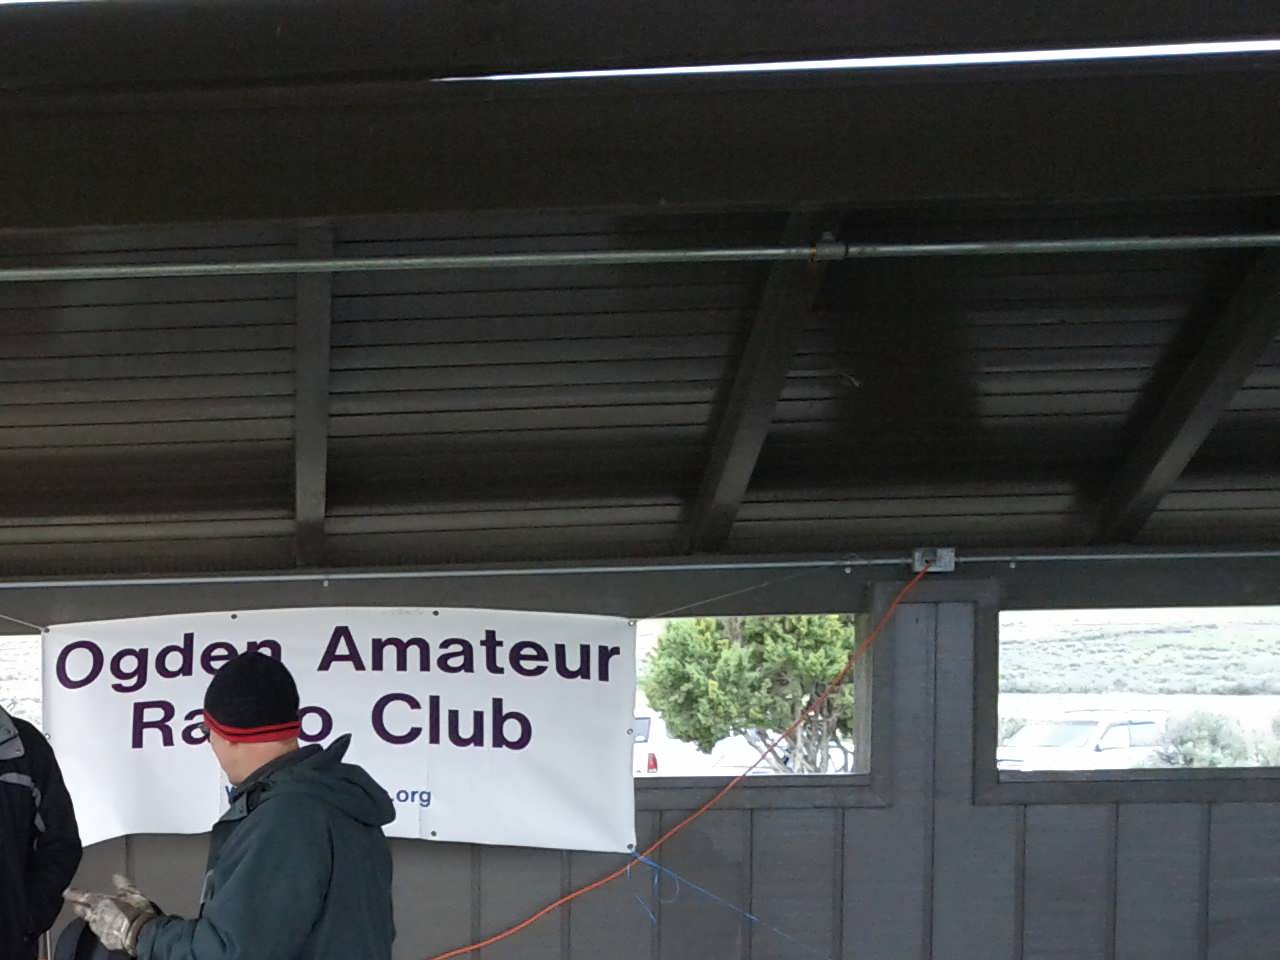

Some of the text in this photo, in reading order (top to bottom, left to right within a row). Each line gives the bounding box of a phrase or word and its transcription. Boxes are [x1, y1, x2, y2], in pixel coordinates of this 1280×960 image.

[316, 625, 621, 682] Amateur
[131, 692, 533, 751] Rao Club
